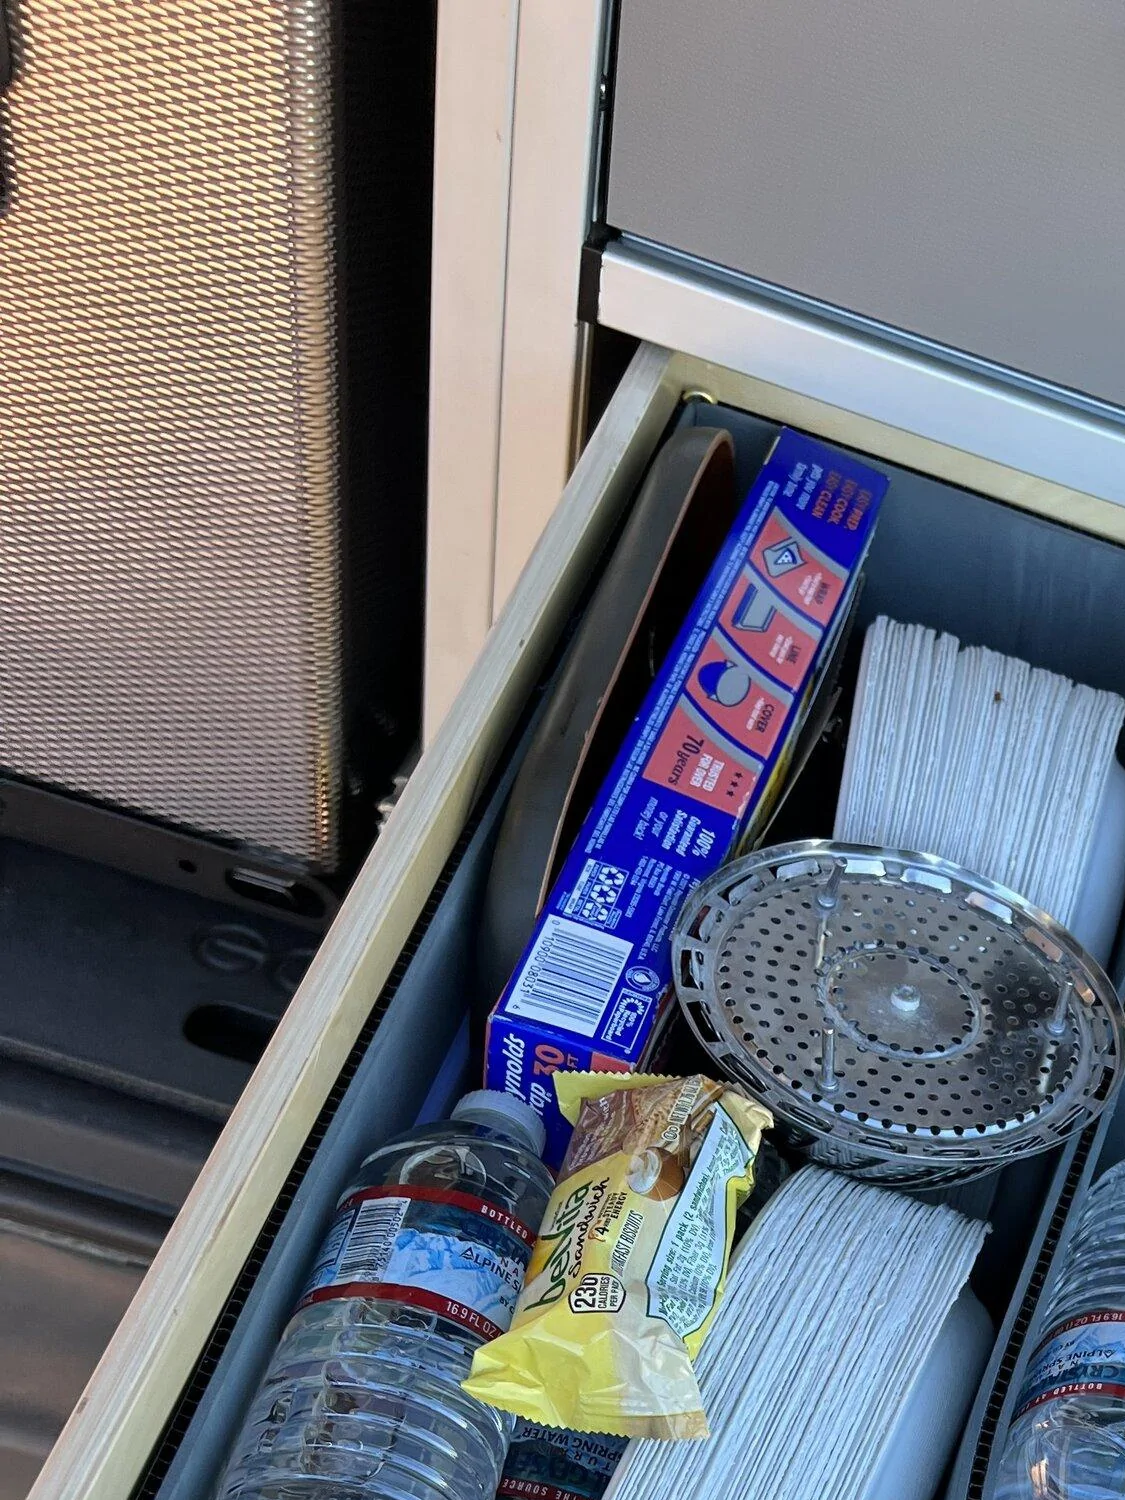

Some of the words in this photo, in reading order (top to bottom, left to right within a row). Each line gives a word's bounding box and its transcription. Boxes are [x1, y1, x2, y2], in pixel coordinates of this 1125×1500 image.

[753, 702, 775, 733] COVER
[680, 733, 704, 755] 70
[665, 749, 692, 787] years
[688, 765, 707, 788] OVER
[697, 752, 713, 769] FOR
[701, 758, 724, 792] TRUSTED
[640, 796, 660, 821] money
[655, 810, 668, 823] or
[632, 818, 651, 840] back!
[647, 821, 663, 838] your
[659, 808, 687, 851] Satisfaction
[673, 814, 701, 857] Guaranteed
[690, 827, 716, 859] 100%
[533, 934, 554, 963] 10900
[519, 963, 540, 995] 08031
[484, 1032, 539, 1098] ynolds
[529, 1042, 566, 1079] 30
[524, 1081, 554, 1115] rap
[609, 1190, 628, 1219] ENERGY
[477, 1204, 531, 1238] BOTTLED
[571, 1177, 612, 1279] Sandwich
[619, 1209, 644, 1243] BISCUITS
[673, 1221, 689, 1241] pack
[682, 1209, 694, 1220] (2
[523, 1180, 592, 1312] belVita
[572, 1272, 606, 1313] 230
[590, 1274, 619, 1310] CALORIES
[608, 1295, 619, 1307] PER
[444, 1301, 468, 1319] 16.9
[467, 1313, 482, 1327] FL
[481, 1320, 497, 1336] OZ
[1089, 1309, 1102, 1324] FL
[1053, 1381, 1103, 1397] BOTTLED
[521, 1426, 568, 1444] WATER
